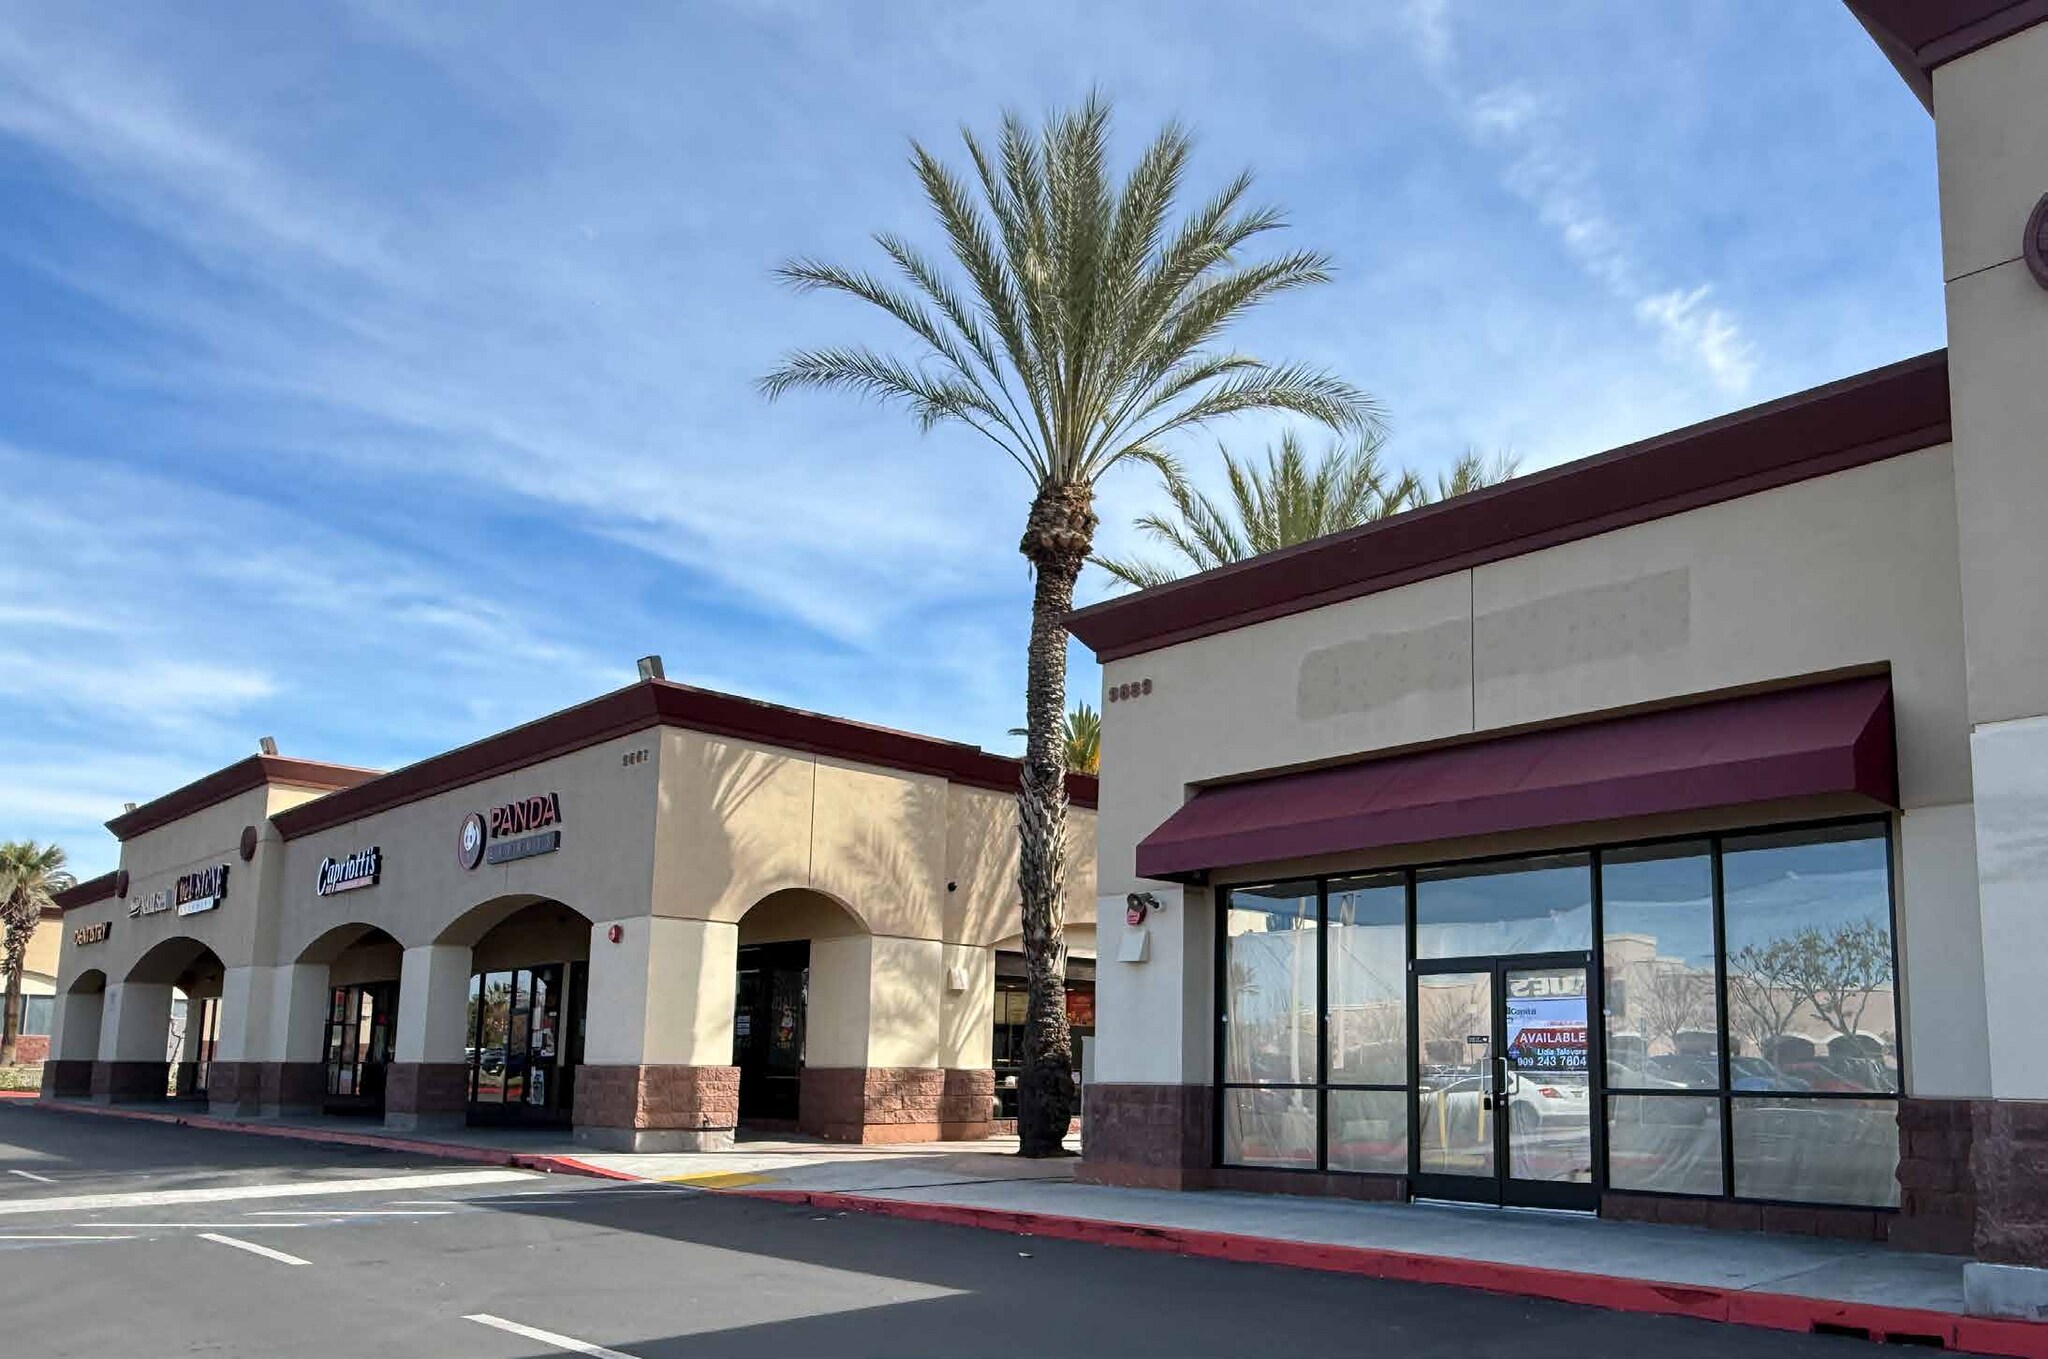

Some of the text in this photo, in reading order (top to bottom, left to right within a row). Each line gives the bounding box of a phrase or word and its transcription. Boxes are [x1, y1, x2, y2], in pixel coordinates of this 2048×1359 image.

[489, 792, 557, 835] PANDA
[316, 846, 377, 896] Capriotti's
[74, 922, 107, 945] DENTISTRY
[1519, 1032, 1587, 1043] AVAILABLE
[1537, 1056, 1557, 1066] 243
